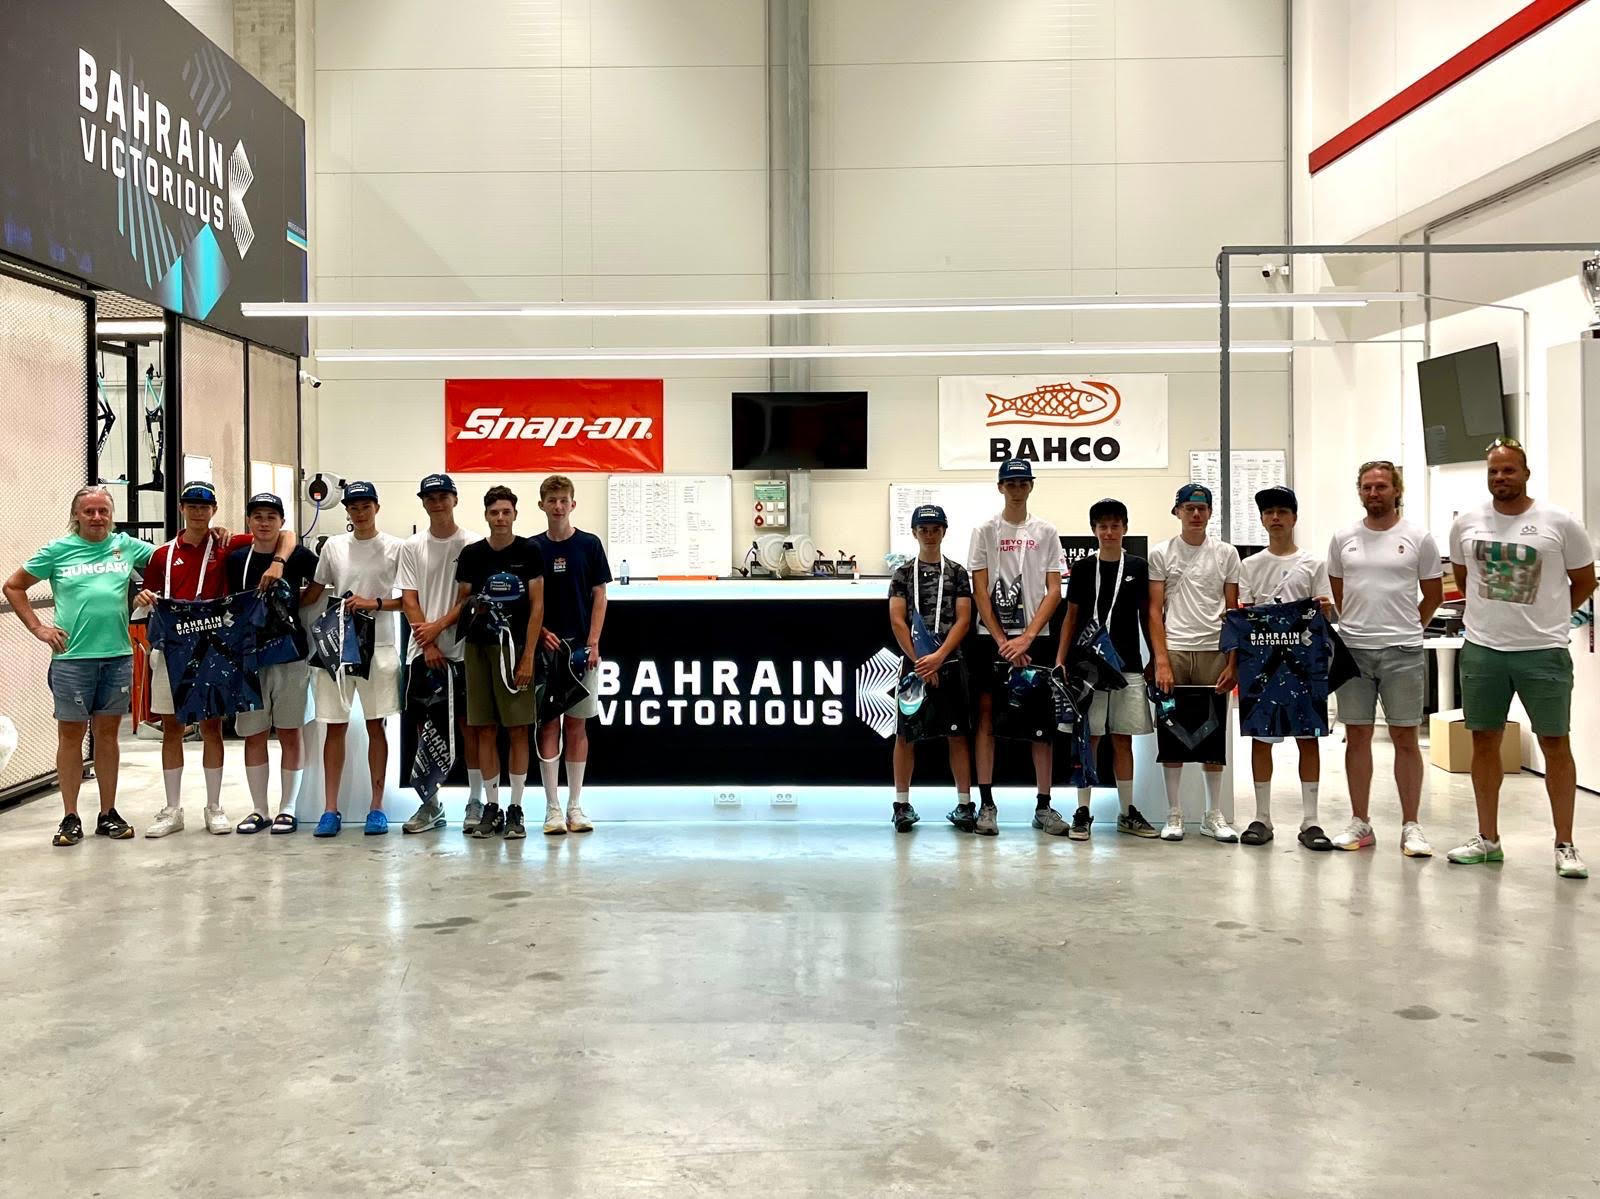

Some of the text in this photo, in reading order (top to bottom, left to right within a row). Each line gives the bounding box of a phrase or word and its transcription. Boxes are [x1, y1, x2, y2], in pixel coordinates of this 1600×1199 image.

[78, 47, 223, 190] BAHRAIN
[80, 116, 224, 231] VICTORIOUS
[456, 407, 653, 446] Snap-on
[990, 437, 1120, 462] BAHCO
[176, 616, 222, 630] BAHRAIN
[177, 623, 222, 635] VICTORIOUS
[1250, 632, 1300, 640] BAHRAIN
[598, 660, 843, 695] BAHRAIN
[598, 700, 843, 725] VICTORIOUS
